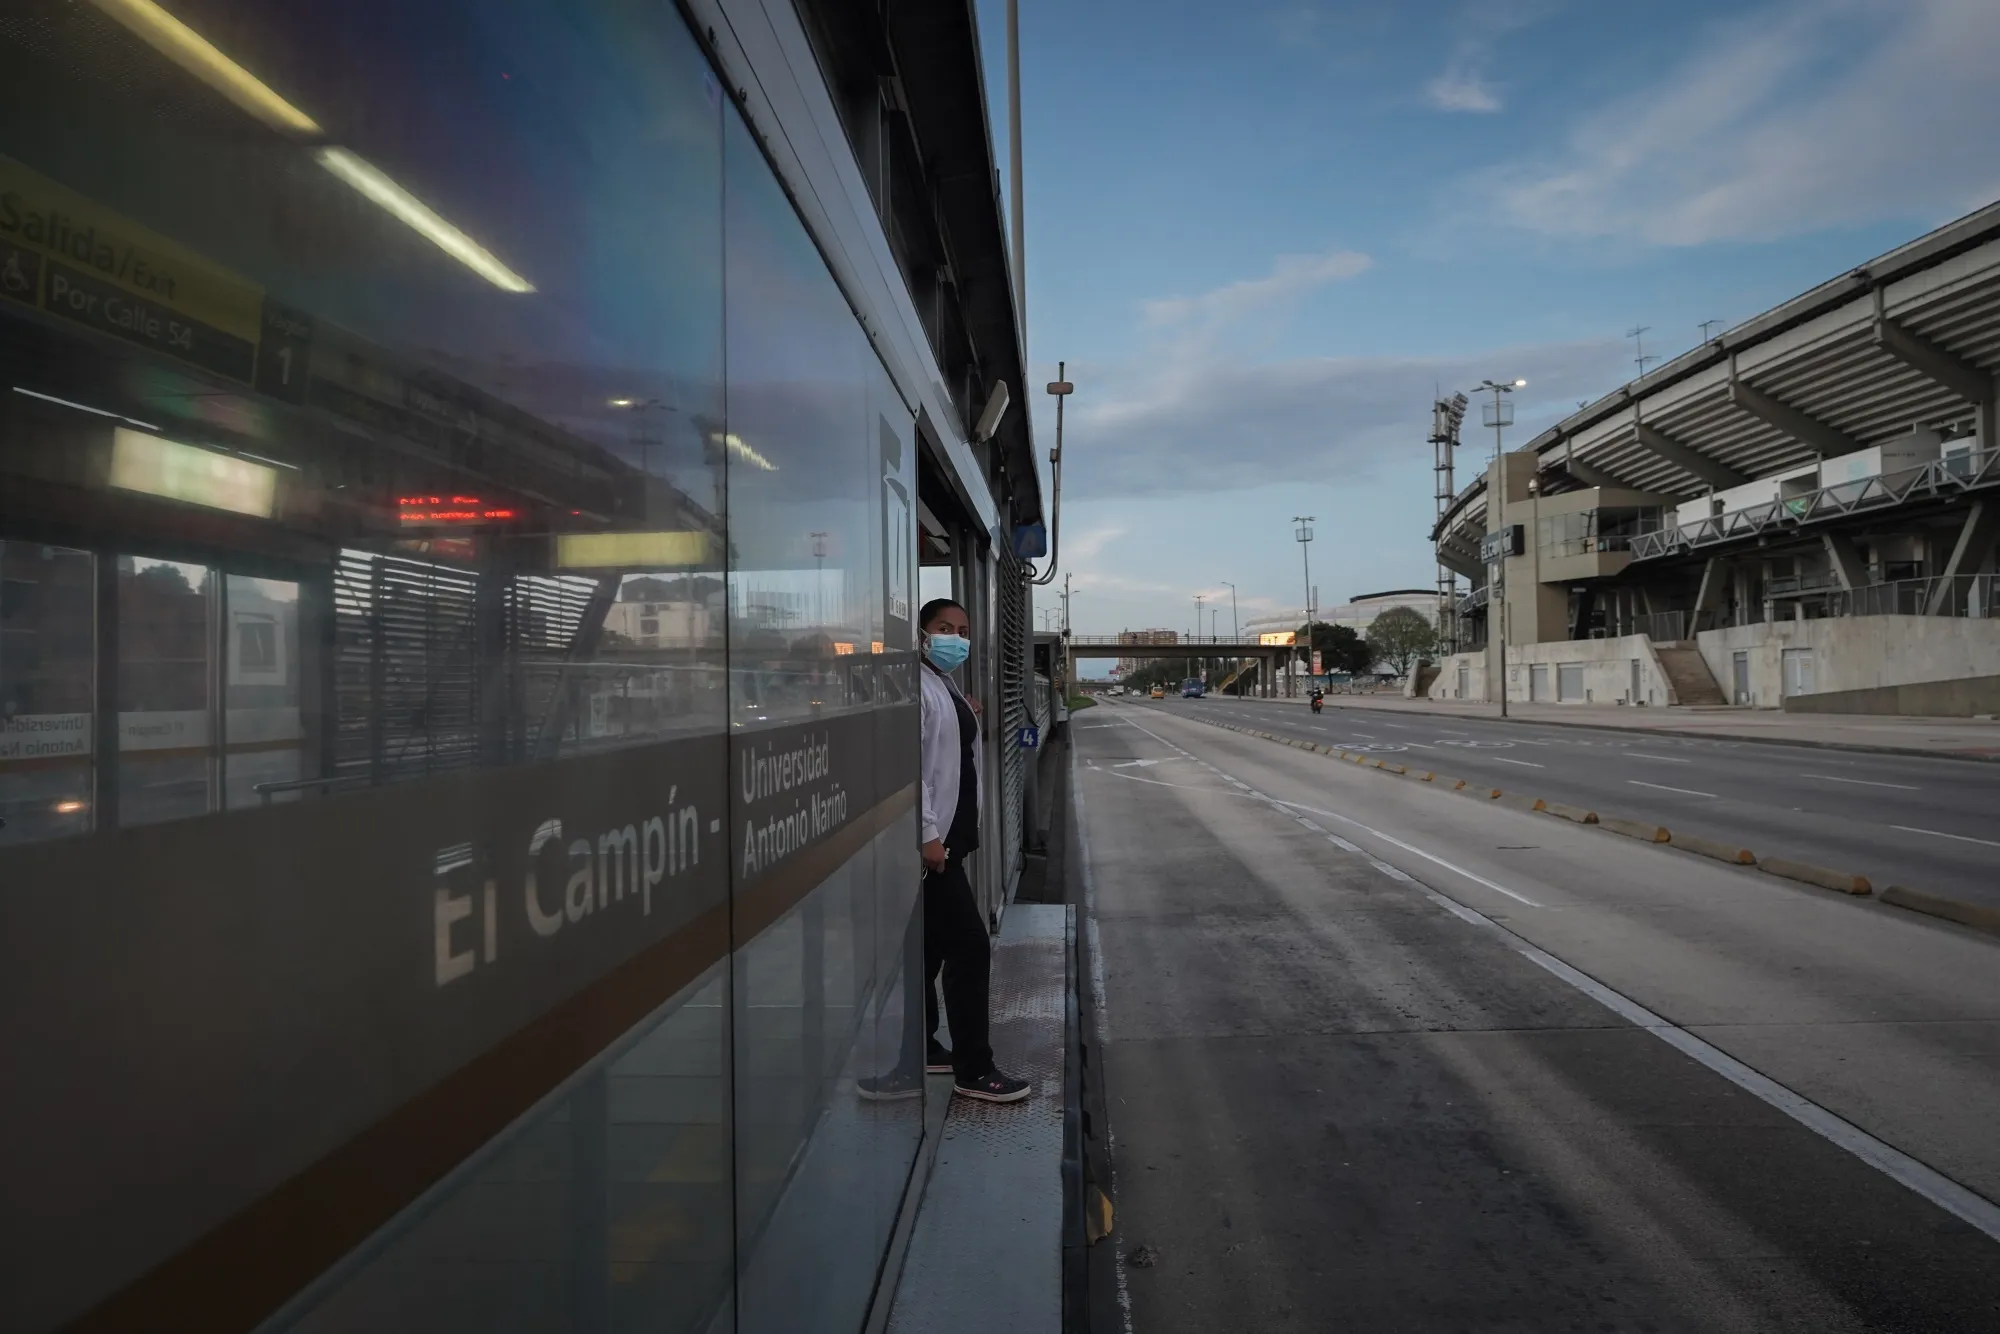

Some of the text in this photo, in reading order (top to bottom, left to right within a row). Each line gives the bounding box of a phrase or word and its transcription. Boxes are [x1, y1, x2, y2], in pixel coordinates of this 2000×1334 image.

[53, 274, 192, 350] Por Calle 54
[276, 347, 292, 385] 1
[742, 731, 829, 805] Universidad
[1022, 729, 1034, 746] 4
[742, 782, 847, 879] Antonio Nariño
[434, 841, 497, 988] El
[525, 784, 699, 936] Campín
